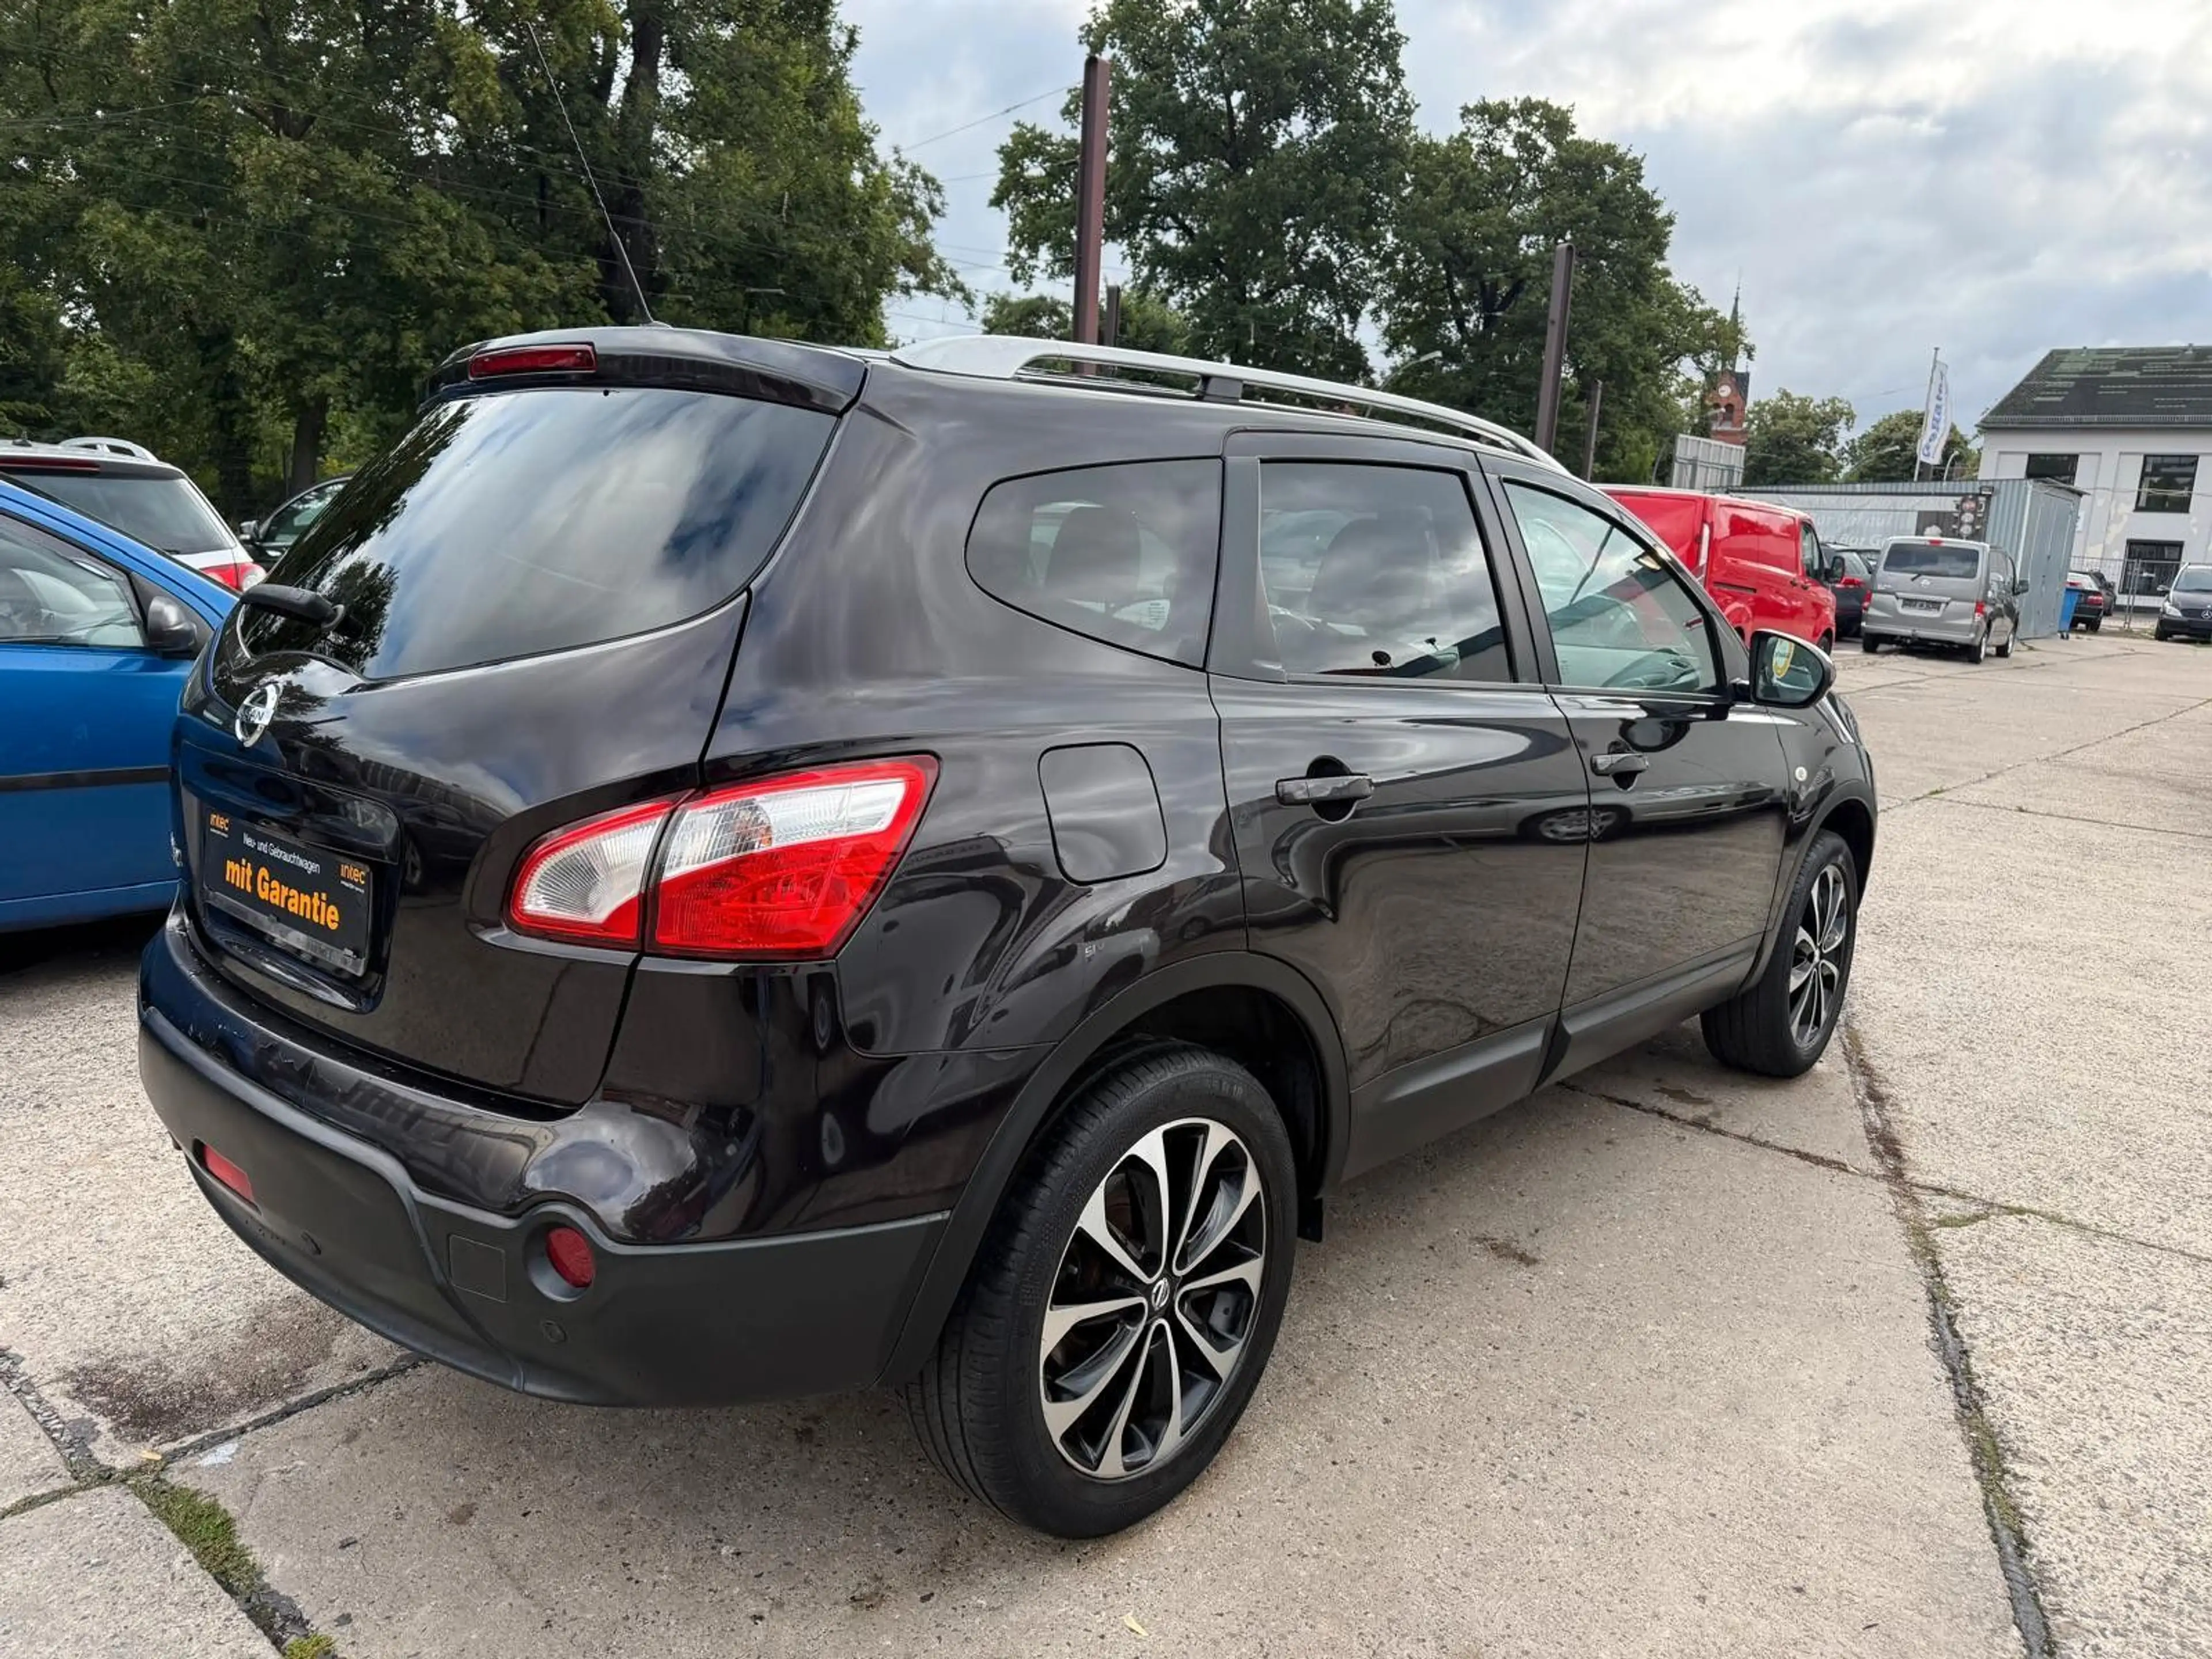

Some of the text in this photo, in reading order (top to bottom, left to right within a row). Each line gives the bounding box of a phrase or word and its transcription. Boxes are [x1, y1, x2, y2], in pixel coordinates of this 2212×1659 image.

[257, 840, 268, 854] und
[340, 863, 366, 885] intec
[225, 858, 340, 930] mit Garantie
